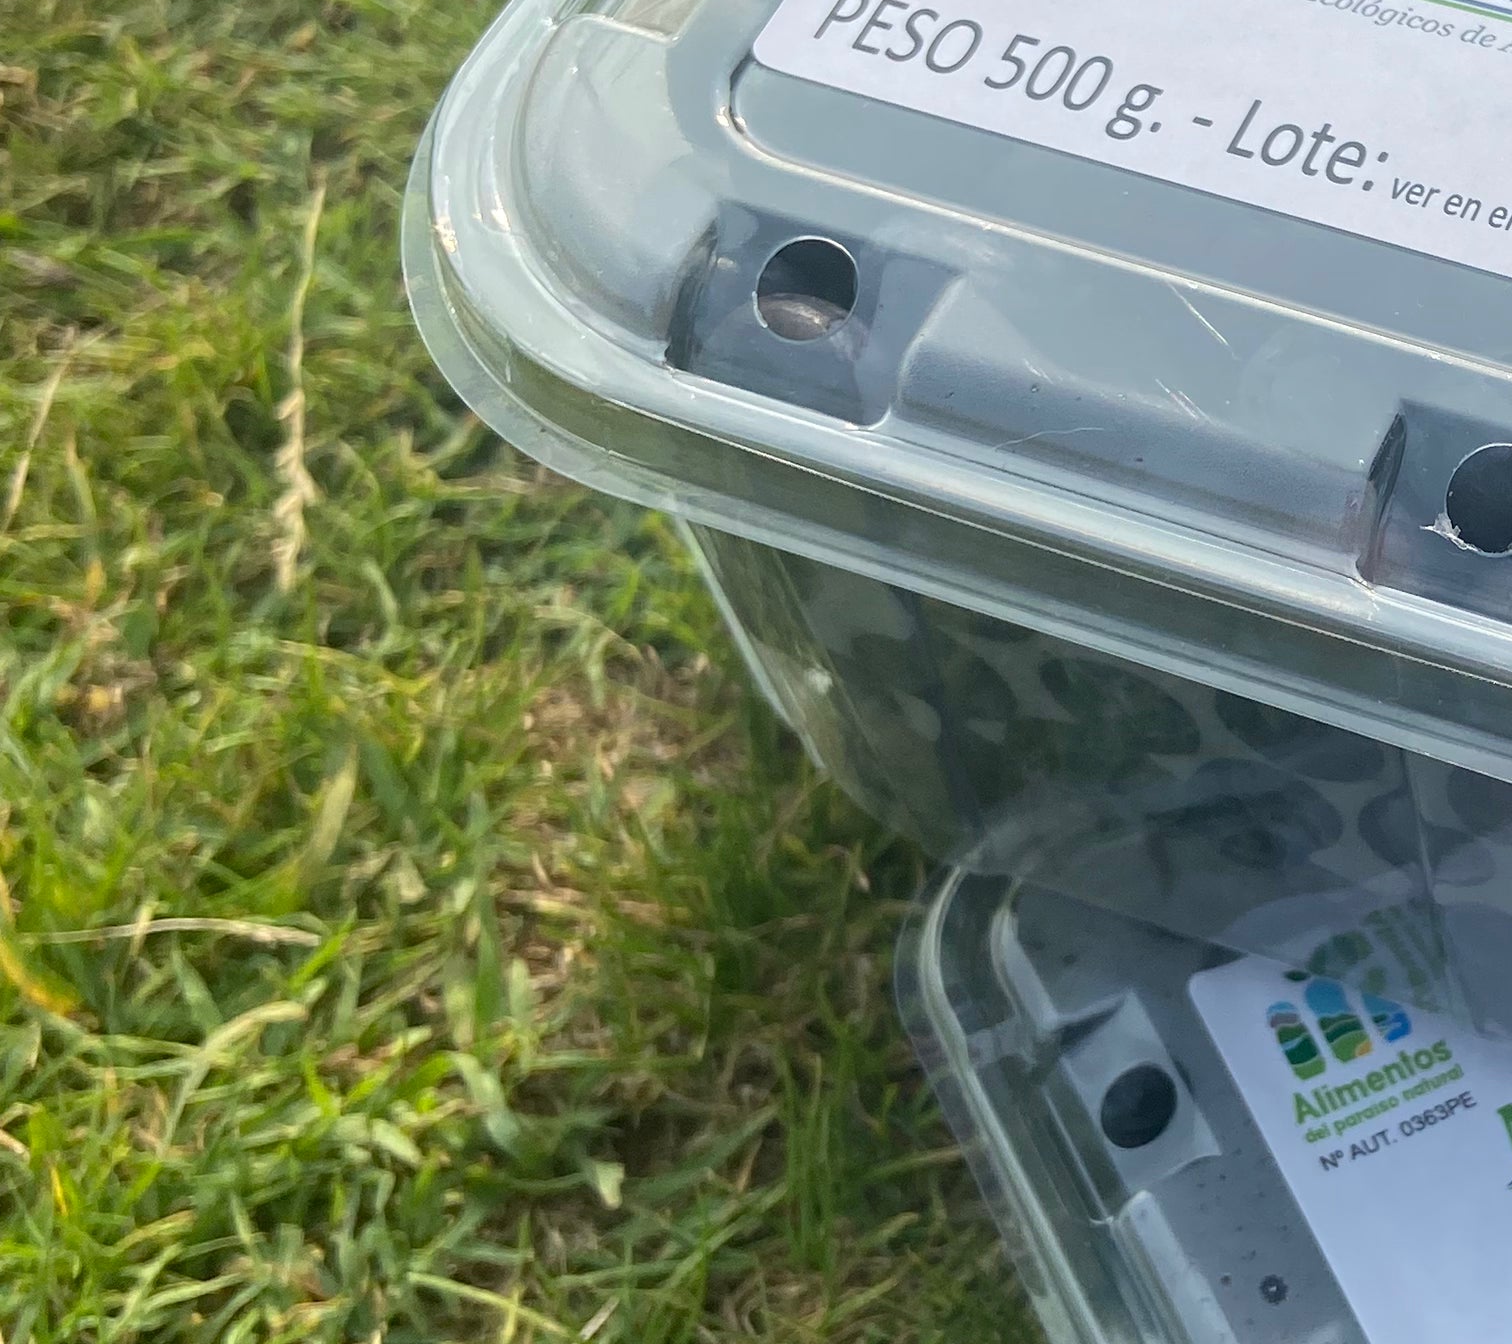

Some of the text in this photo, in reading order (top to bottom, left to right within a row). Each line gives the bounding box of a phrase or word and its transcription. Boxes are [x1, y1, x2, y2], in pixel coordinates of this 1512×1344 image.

[1459, 24, 1497, 48] de
[983, 33, 1115, 111] 500
[1104, 83, 1165, 141] g.
[1225, 98, 1390, 192] Lote:
[1390, 177, 1441, 210] ver
[1443, 193, 1482, 222] en
[1293, 1039, 1453, 1125] Alimentos
[1305, 1124, 1332, 1144] del
[1402, 1063, 1465, 1102] natural
[1349, 1128, 1398, 1160] AUT.
[1400, 1090, 1478, 1138] 0363PE
